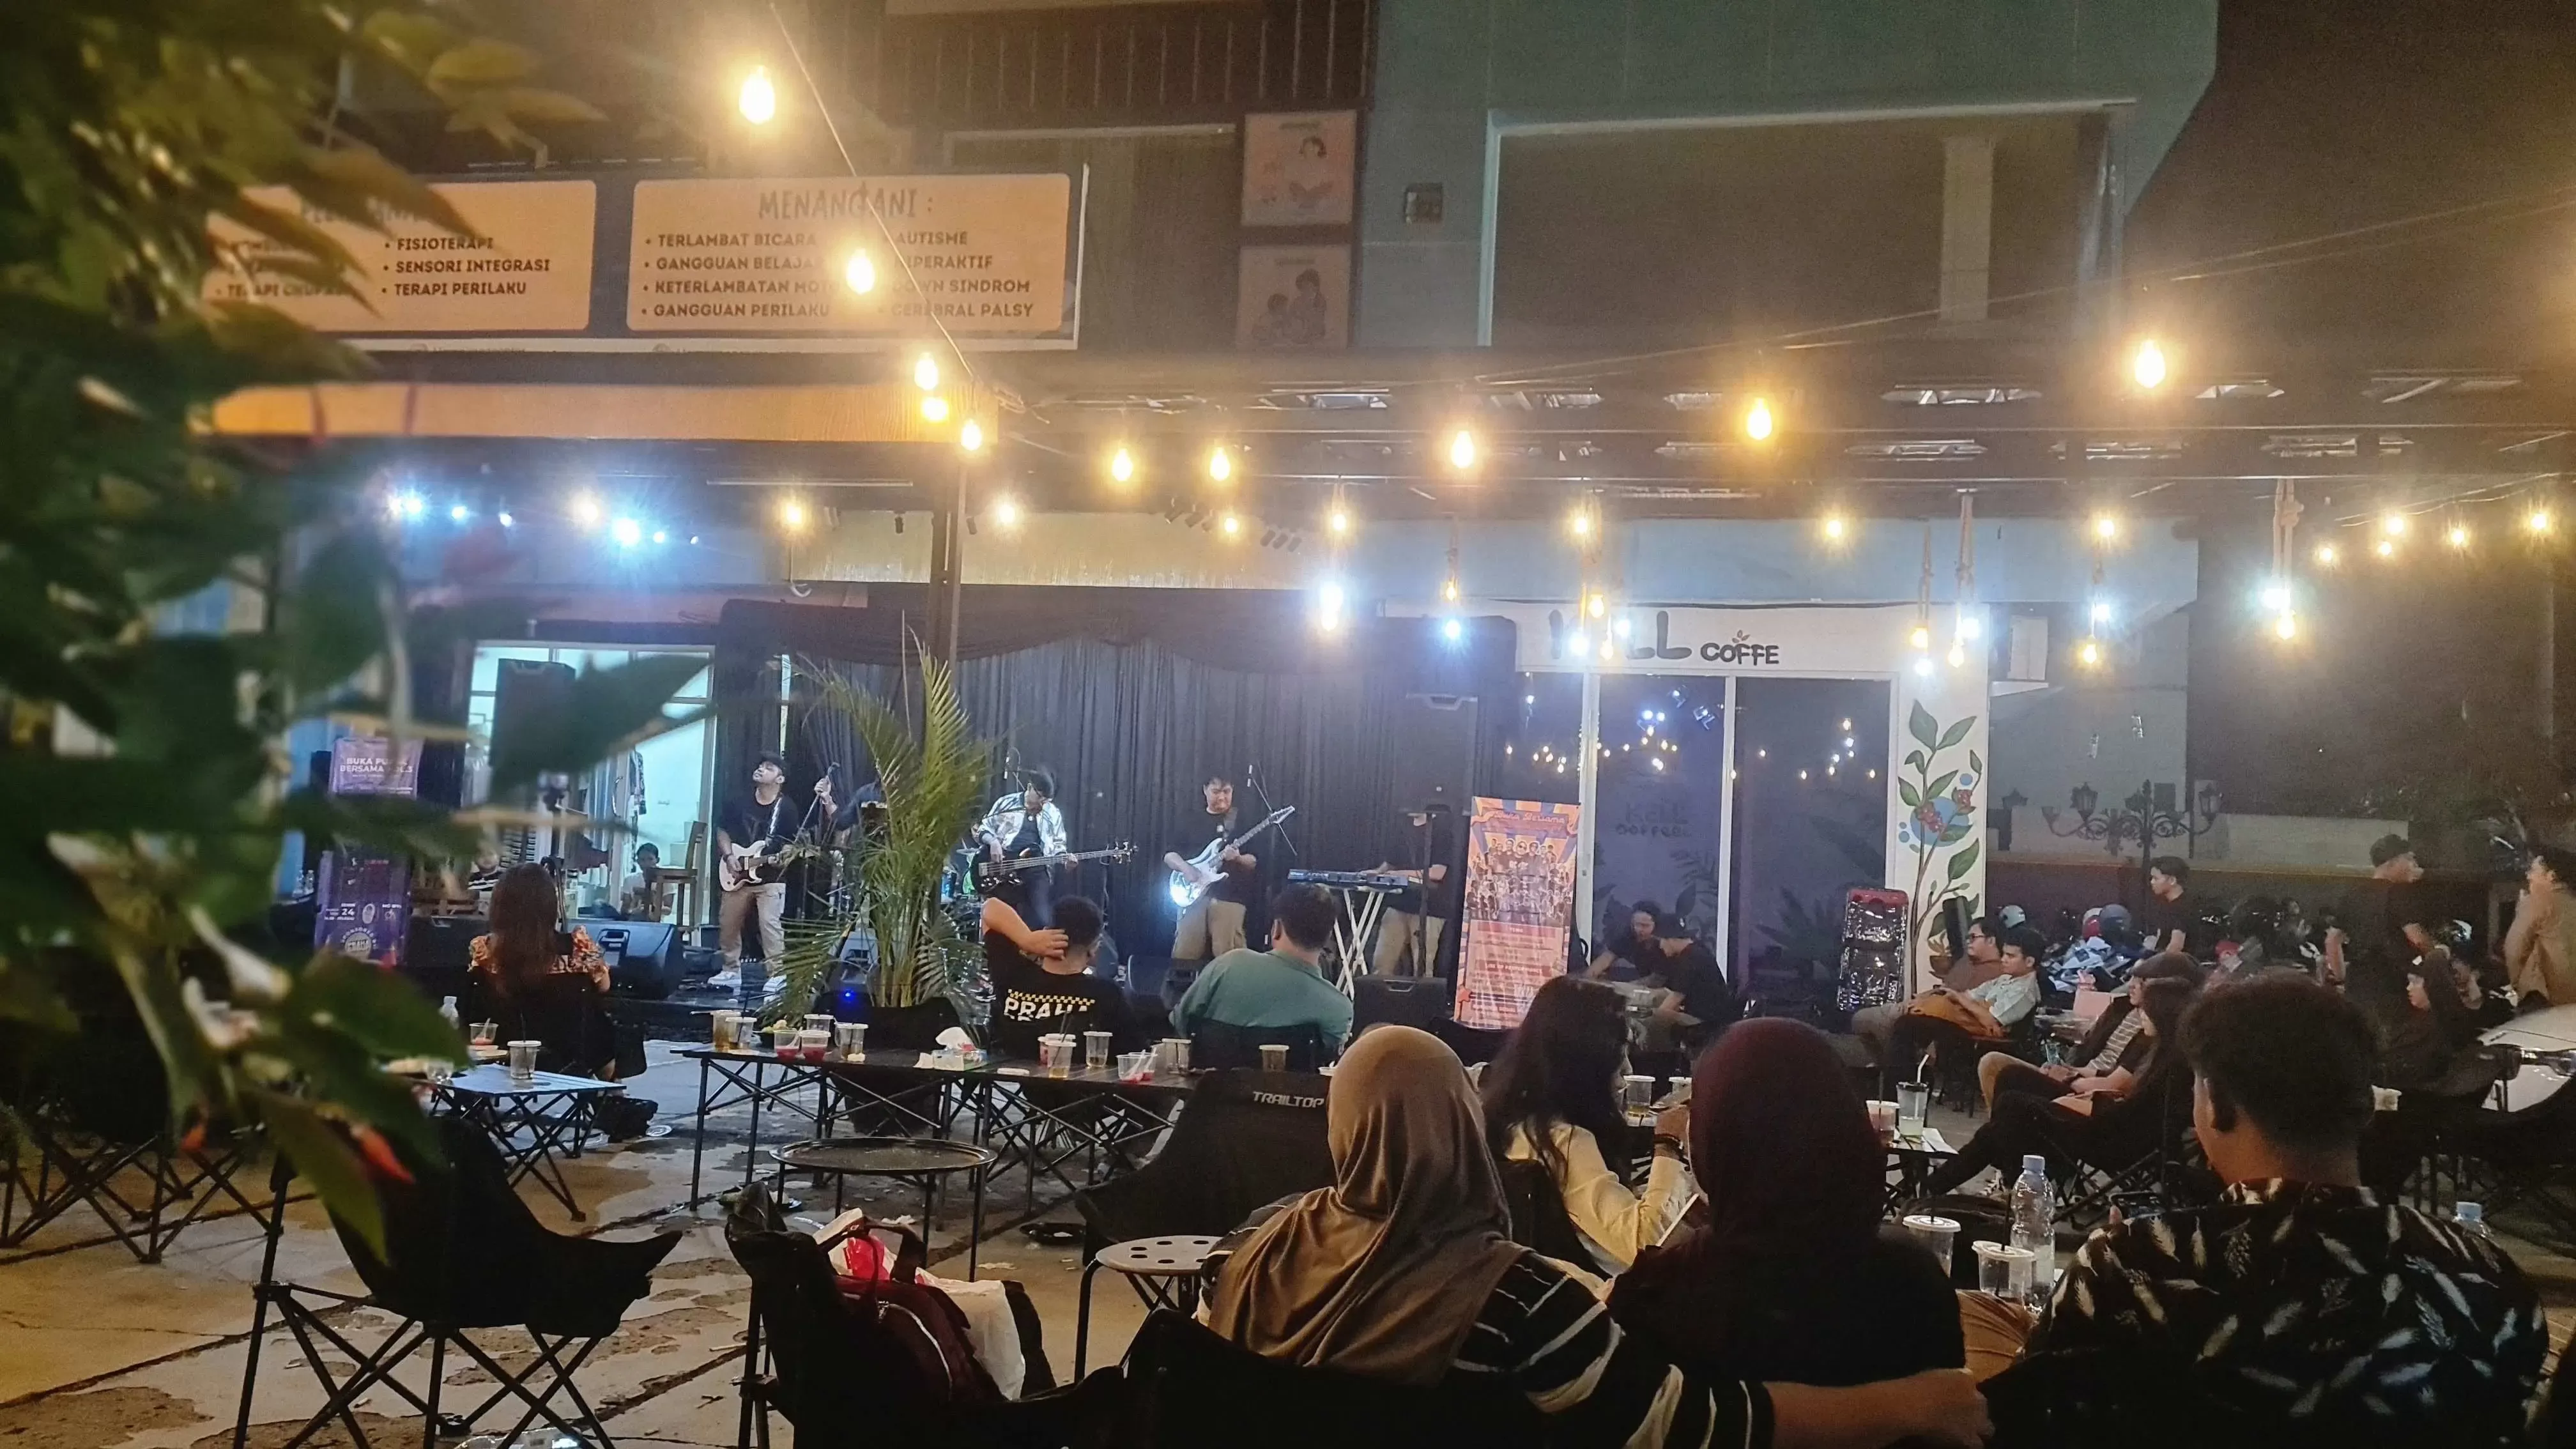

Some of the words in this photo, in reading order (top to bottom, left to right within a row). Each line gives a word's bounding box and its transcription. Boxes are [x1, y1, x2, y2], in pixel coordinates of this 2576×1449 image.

[397, 237, 493, 250] FISIOTERAPI
[658, 233, 749, 247] TERLAMBAT
[754, 233, 816, 247] BICARA
[896, 231, 968, 245] AUTISME
[396, 260, 461, 273] SENSORI
[466, 258, 550, 272] INTEGRASI
[656, 256, 748, 270] GANGGUAN
[753, 256, 824, 270] BELAJA
[394, 283, 447, 296] TERAPI
[452, 282, 526, 296] PERILAKU
[655, 280, 788, 294] KETERLAMBATAN
[950, 279, 1030, 293] SINDROM
[654, 303, 746, 317] GANGGUAN
[751, 303, 830, 318] PERILAKU
[981, 303, 1033, 318] PALSY
[1700, 642, 1779, 666] COFFE
[341, 908, 355, 916] 24
[1253, 1091, 1324, 1108] TRAILTOP
